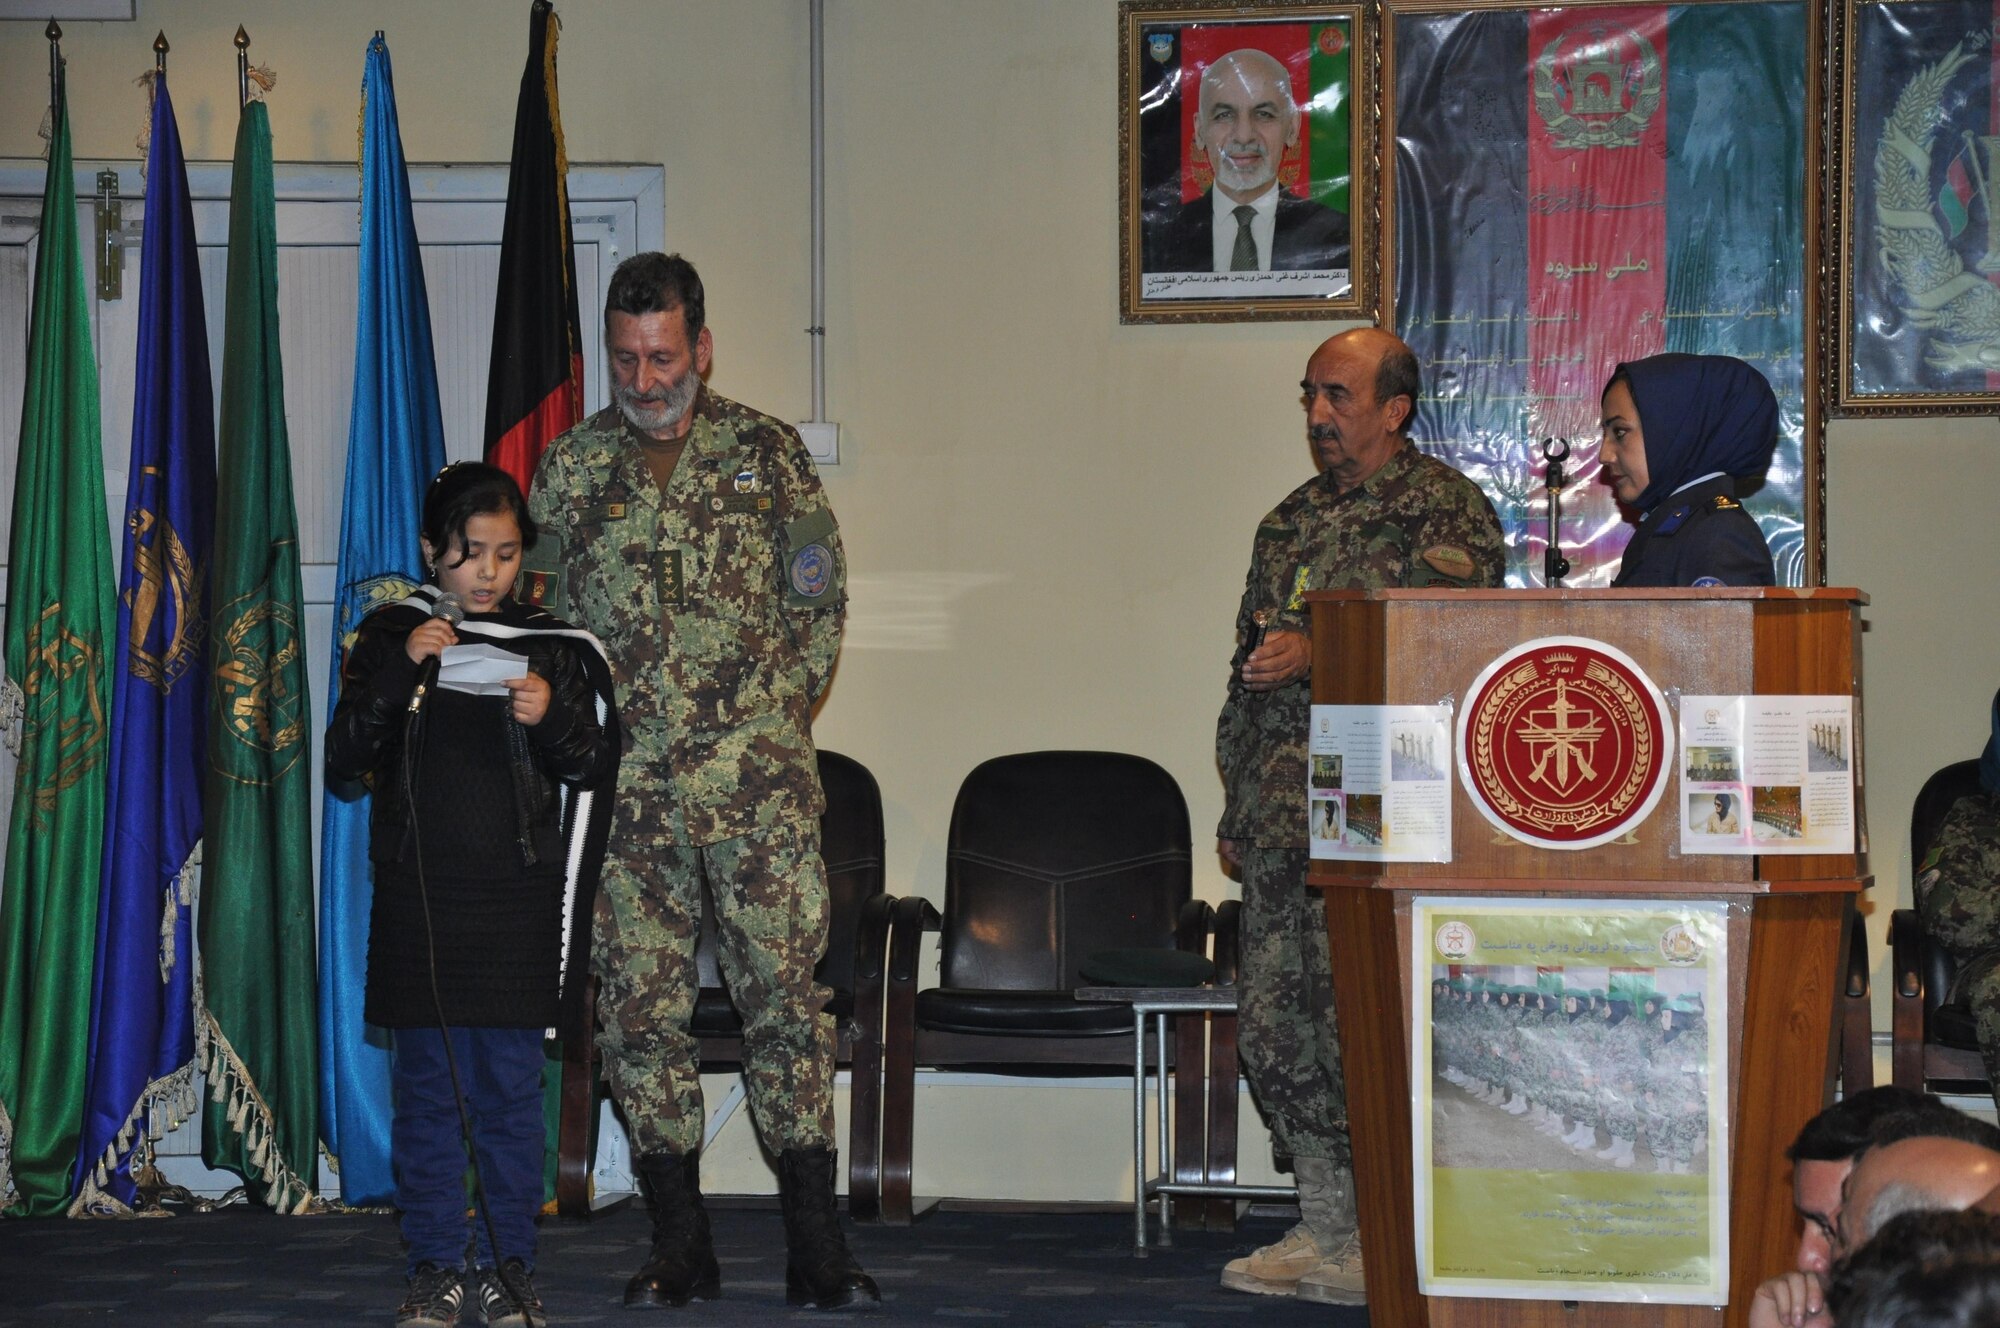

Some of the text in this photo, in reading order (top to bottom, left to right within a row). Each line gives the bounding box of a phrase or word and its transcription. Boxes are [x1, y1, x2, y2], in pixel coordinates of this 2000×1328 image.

[1147, 275, 1178, 286] افغانستان
[1290, 272, 1310, 282] اشرف
[1546, 663, 1560, 676] اکبر
